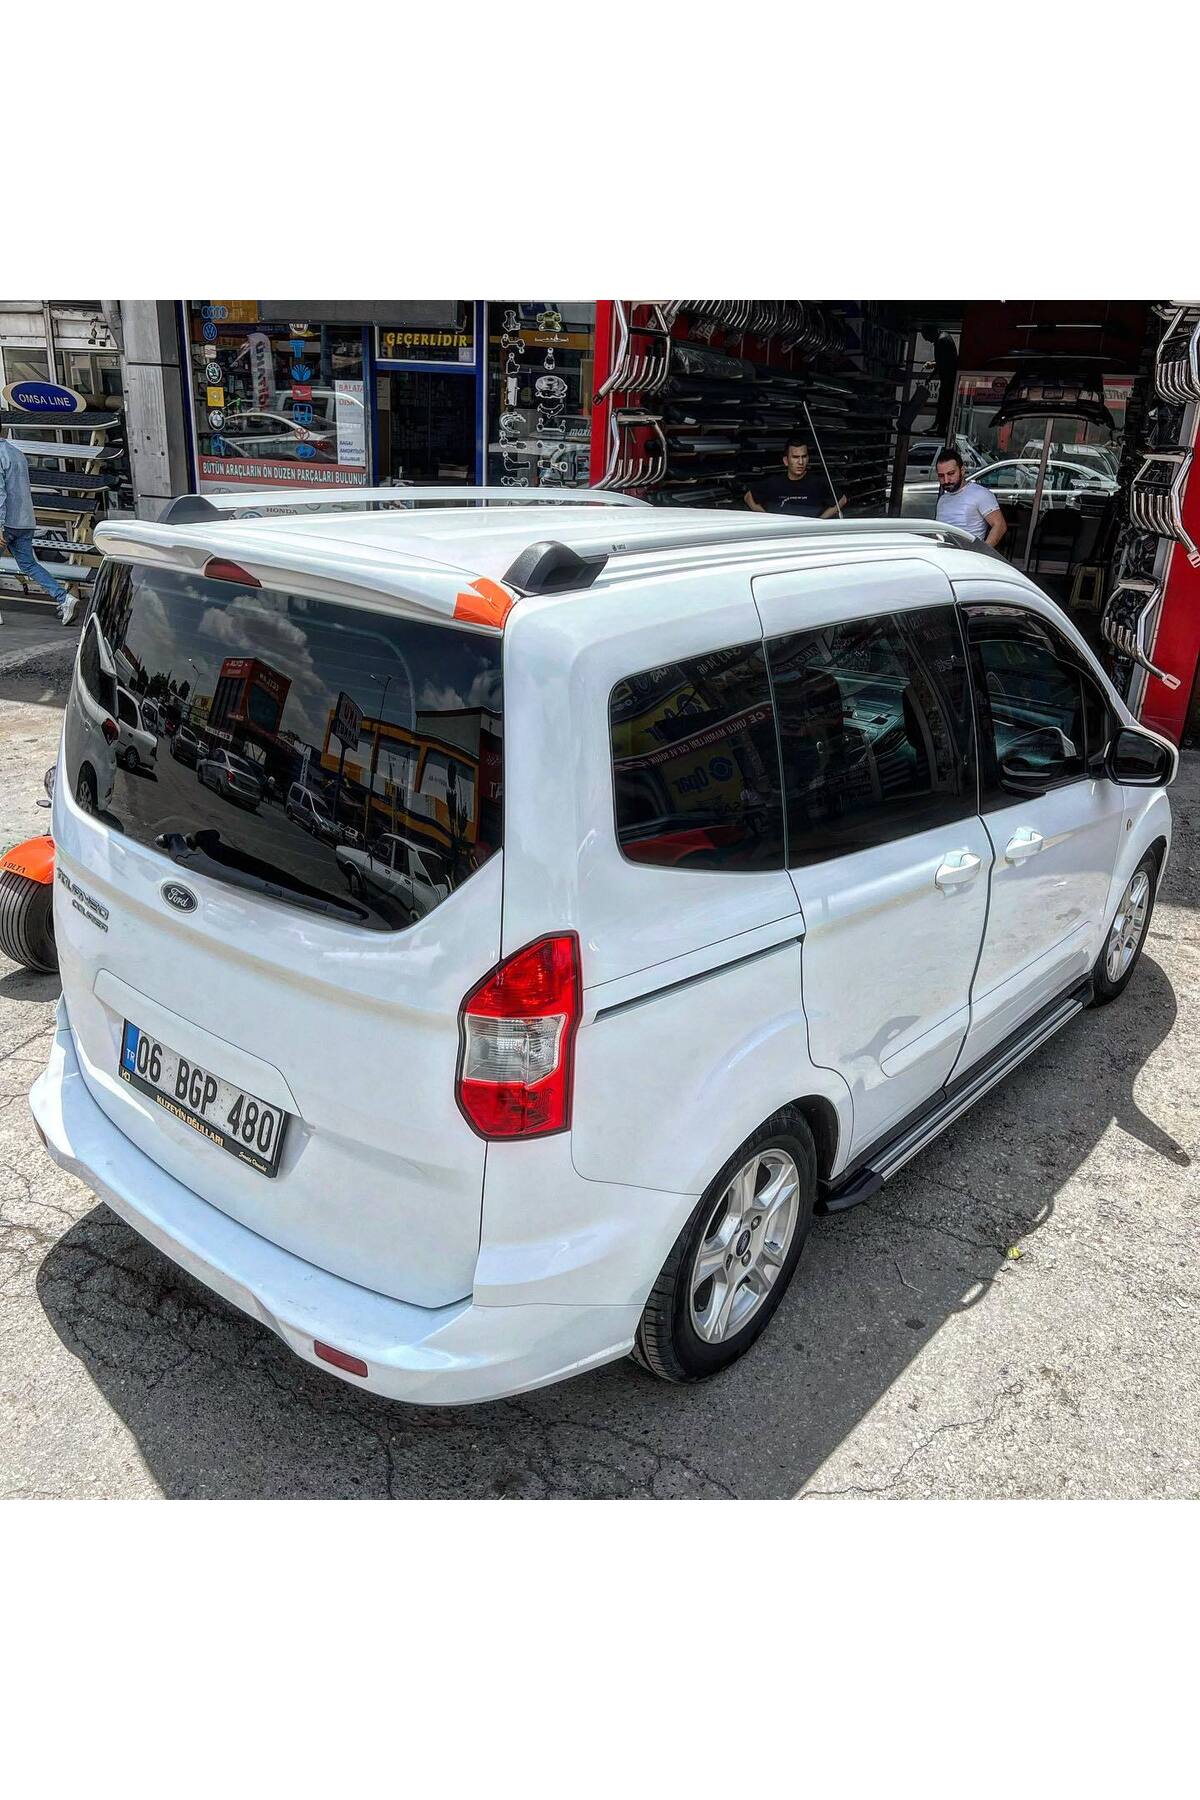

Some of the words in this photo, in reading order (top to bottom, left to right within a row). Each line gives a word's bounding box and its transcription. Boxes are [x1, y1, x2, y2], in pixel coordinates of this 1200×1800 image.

[386, 331, 467, 348] GEÇERLİDİR
[18, 393, 48, 405] OMSA
[48, 396, 71, 407] LINE
[203, 461, 225, 476] BÜTÜN
[225, 464, 262, 479] ARAÇLARIN
[263, 465, 273, 479] ÖN
[273, 466, 296, 480] DÜZEN
[297, 469, 334, 483] PARÇALARI
[3, 862, 26, 874] VOLTA
[56, 866, 109, 920] TOURNEO
[168, 887, 188, 908] Ford
[126, 1048, 135, 1063] TR
[136, 1036, 163, 1083] 06
[175, 1059, 218, 1115] BGP
[227, 1094, 275, 1153] 480
[186, 1113, 225, 1147] OĞULLARI
